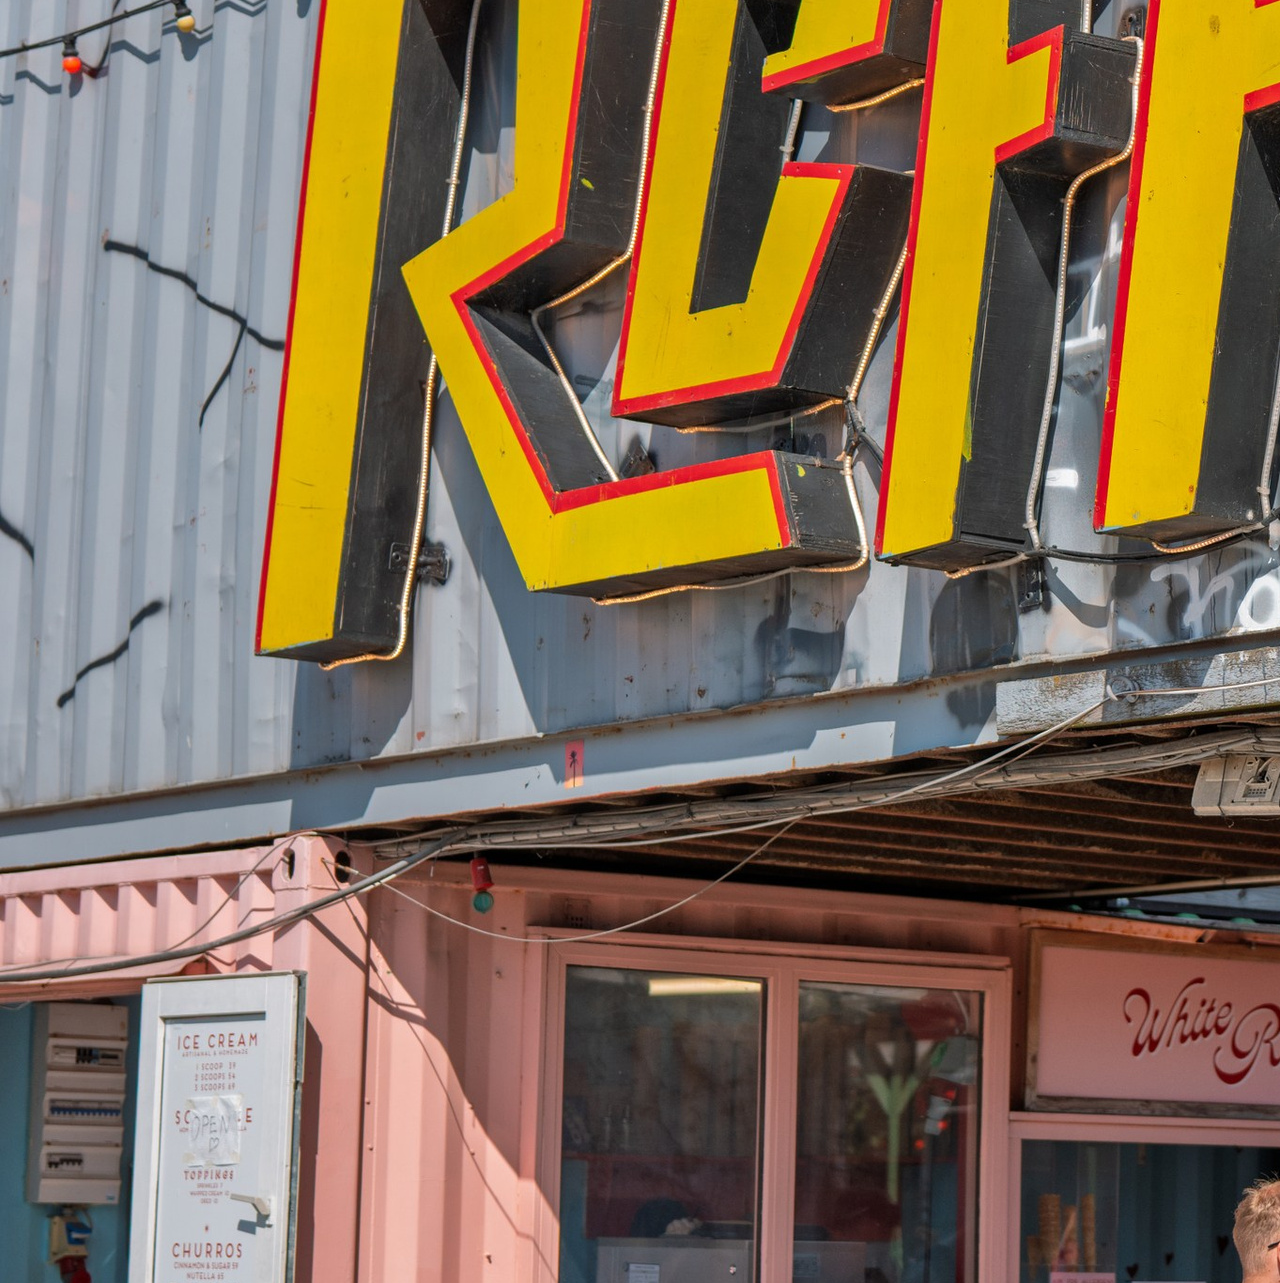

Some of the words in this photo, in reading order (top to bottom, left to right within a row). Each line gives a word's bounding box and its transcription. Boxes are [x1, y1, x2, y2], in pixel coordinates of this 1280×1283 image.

[1123, 976, 1233, 1058] White
[177, 1034, 200, 1050] ICE
[207, 1033, 257, 1048] CREAM
[201, 1062, 223, 1071] SCOOP
[200, 1072, 225, 1081] SCOOPS
[200, 1082, 225, 1091] SCOOPS
[190, 1114, 230, 1141] OPEN
[183, 1169, 234, 1181] TOPPINGS
[172, 1242, 243, 1258] CHURROS
